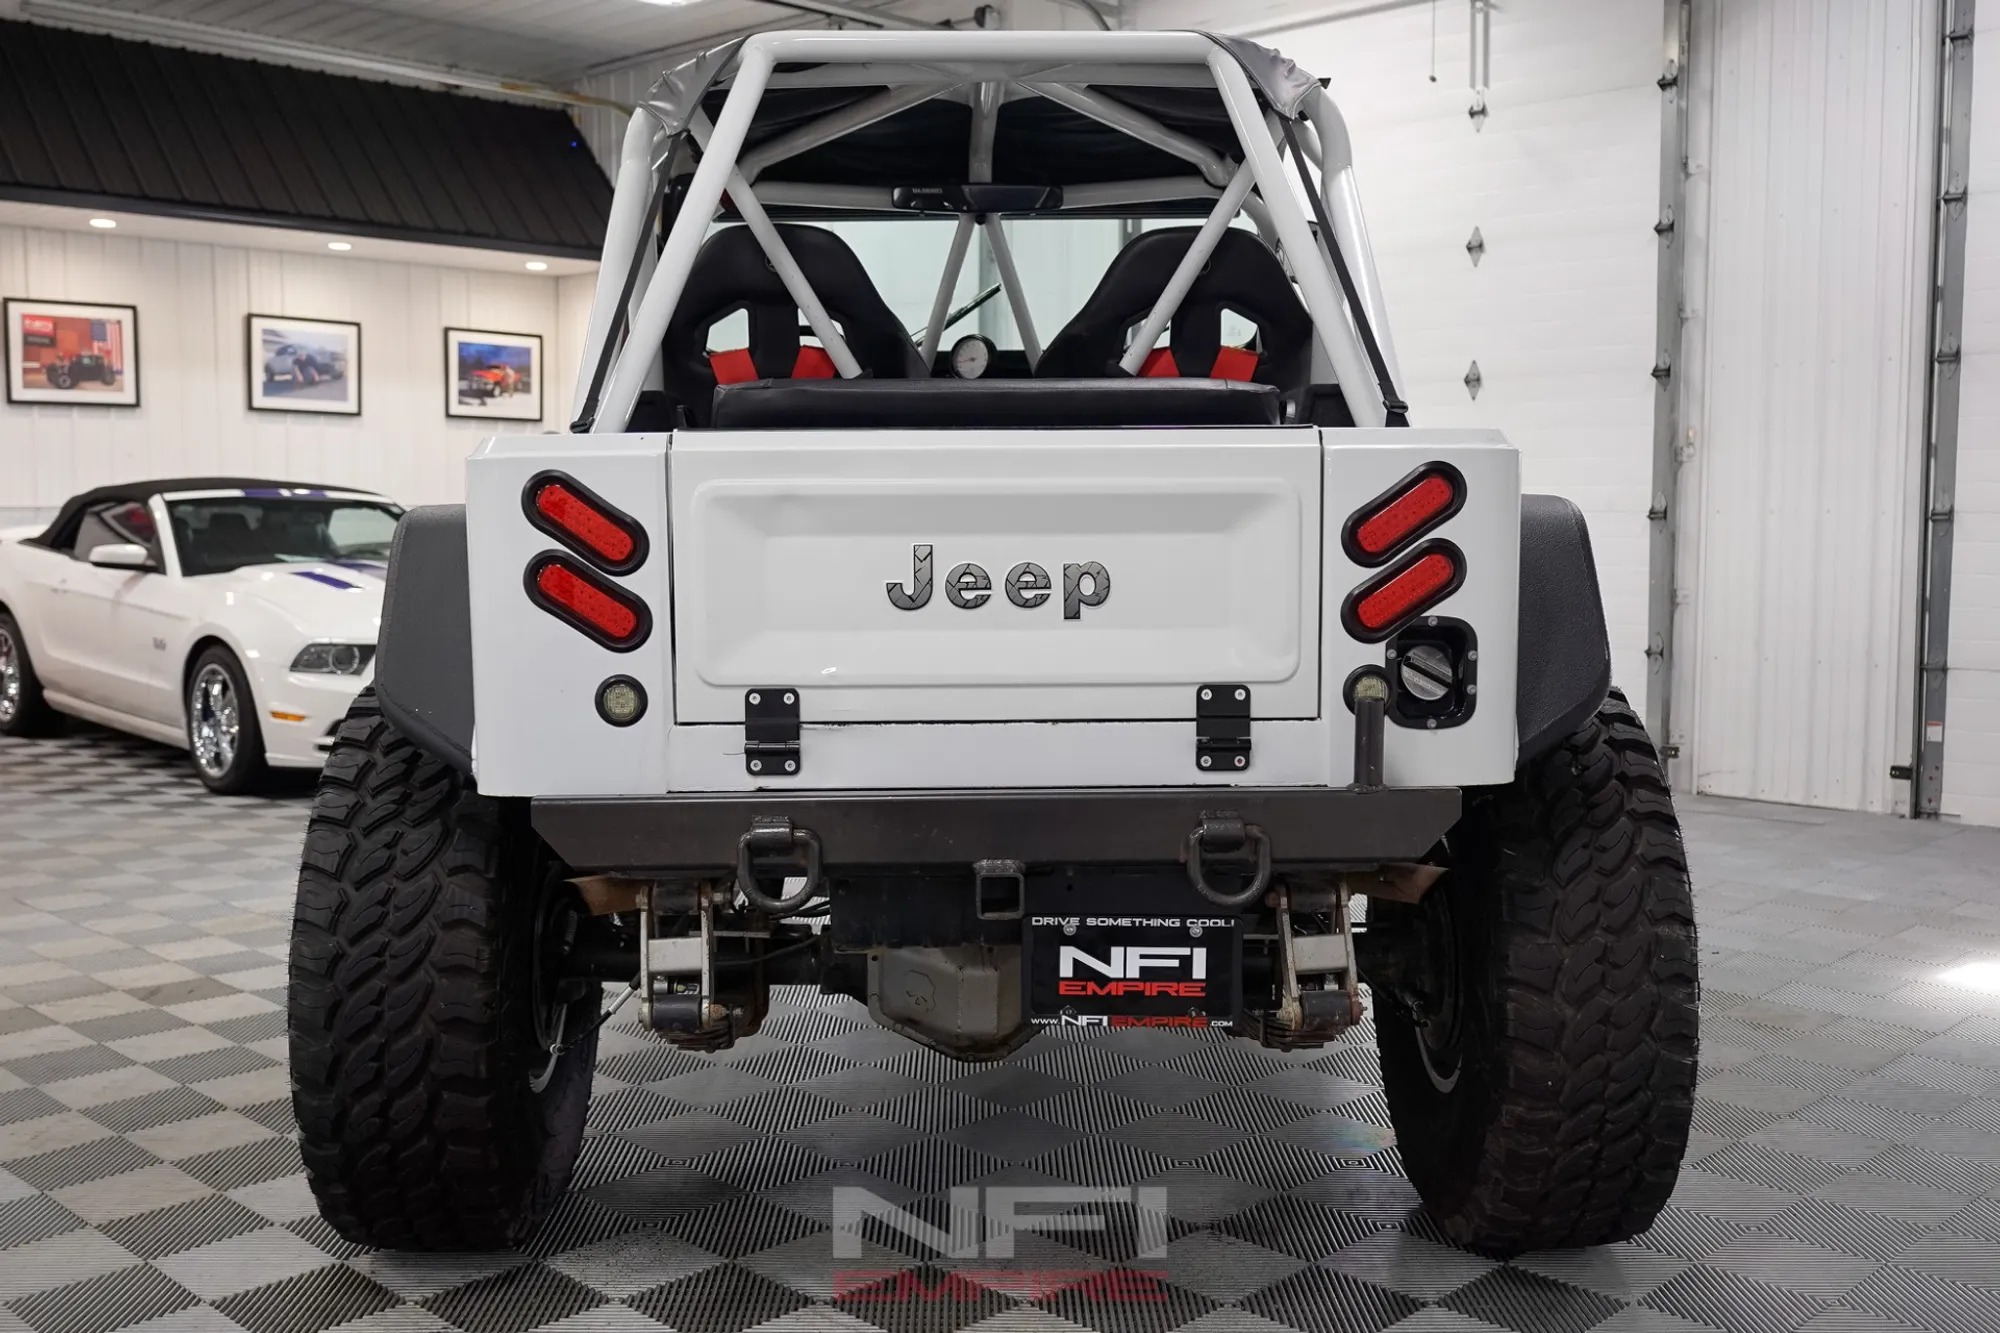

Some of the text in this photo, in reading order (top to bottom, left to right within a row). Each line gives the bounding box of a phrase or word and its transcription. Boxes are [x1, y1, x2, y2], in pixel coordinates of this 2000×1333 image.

[886, 543, 1111, 621] Jeep
[1031, 917, 1235, 928] DRIVE SOMETHING COOL!
[1059, 945, 1207, 979] NFI
[1058, 980, 1207, 997] EMPIRE
